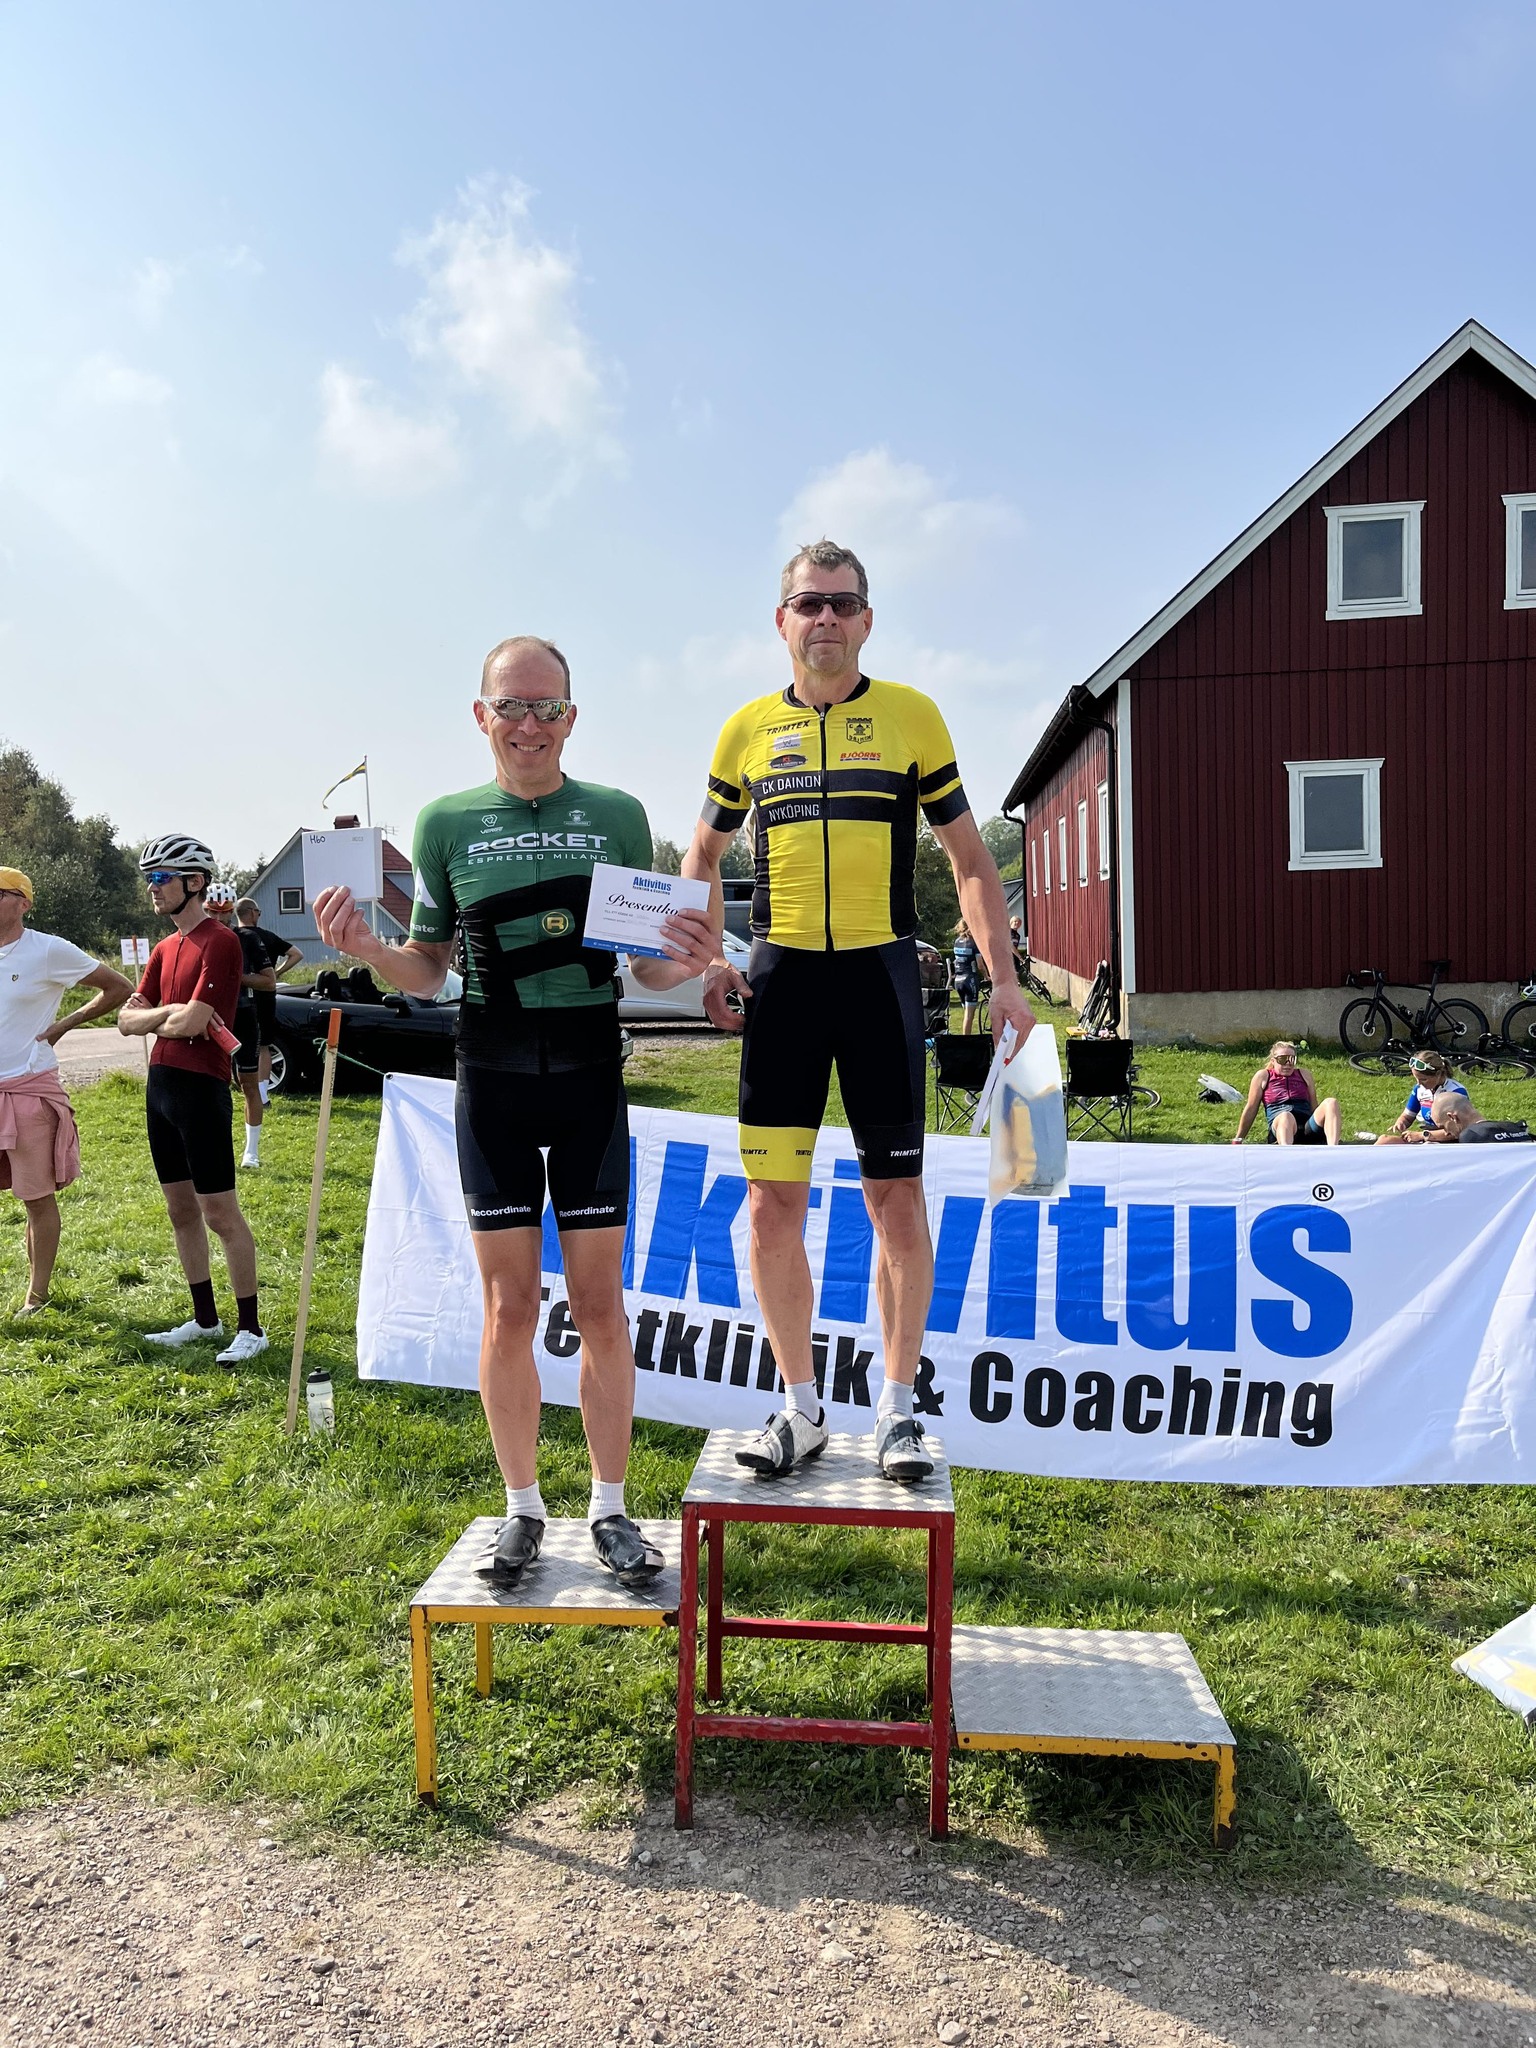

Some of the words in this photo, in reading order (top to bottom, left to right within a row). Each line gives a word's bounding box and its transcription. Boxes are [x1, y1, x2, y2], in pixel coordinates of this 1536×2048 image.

[766, 720, 811, 735] TRIMTEX
[840, 751, 882, 759] BJÖÖRNS
[762, 781, 776, 795] CK
[777, 775, 821, 791] DAINON
[768, 803, 820, 823] NYKÖPING
[467, 832, 608, 855] ROCKET
[467, 853, 545, 866] ESPRESSO
[553, 853, 608, 862] MILANO
[633, 876, 672, 892] Aktivitus
[605, 893, 681, 917] Presentko
[1494, 1132, 1511, 1141] CK
[889, 1147, 921, 1157] TRIMTEX
[470, 1205, 531, 1217] Recoordinate
[558, 1204, 617, 1218] Recoordinate
[541, 1136, 1354, 1359] kivitus
[541, 1286, 875, 1408] etklinik
[968, 1350, 1334, 1448] Coaching
